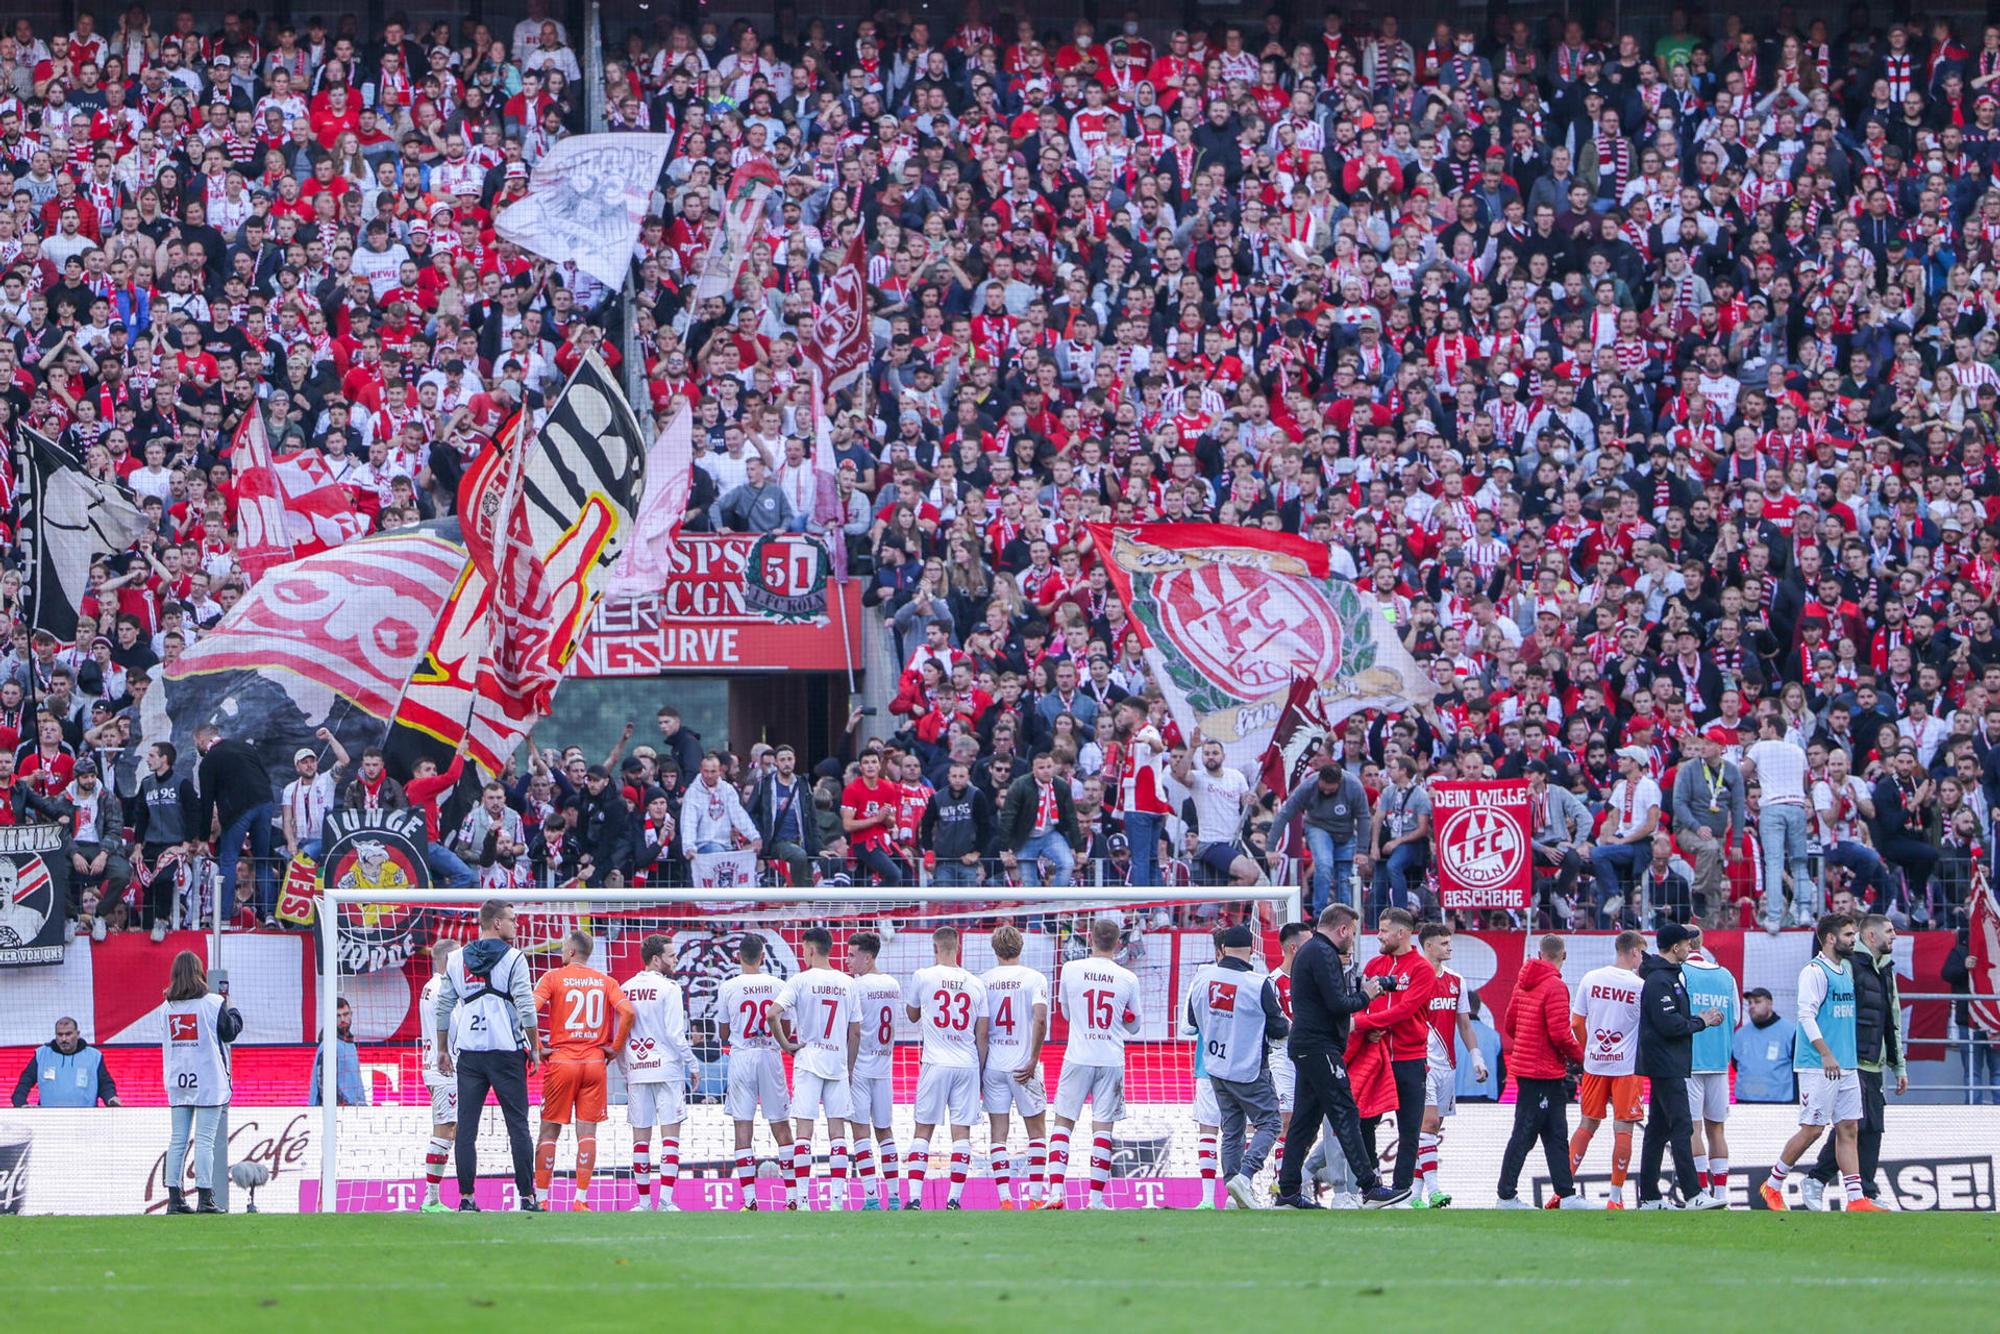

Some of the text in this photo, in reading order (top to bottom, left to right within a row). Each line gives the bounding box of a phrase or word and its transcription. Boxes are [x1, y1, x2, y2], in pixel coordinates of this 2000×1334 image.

[370, 270, 397, 280] REWE
[670, 540, 746, 575] SPS
[765, 557, 810, 589] 51
[666, 580, 746, 616] CGN
[661, 629, 740, 662] URVE
[160, 787, 176, 799] 96
[1435, 787, 1528, 808] DEIN WILLE
[327, 807, 424, 840] JUNGE
[1457, 830, 1503, 865] 1.FC
[1459, 863, 1505, 880] KÖLN
[281, 860, 318, 918] SEK
[1443, 889, 1524, 908] GESCHEHE
[19, 948, 41, 961] VON
[44, 946, 63, 960] UNS
[942, 979, 964, 991] DIETZ
[989, 980, 1022, 990] HÜBERS
[1084, 971, 1115, 984] KILIAN
[743, 985, 773, 996] SKHIRI
[1591, 985, 1636, 1004] REWE
[1692, 992, 1729, 1008] REWE
[564, 988, 605, 1030] 20
[821, 998, 839, 1039] 7
[933, 989, 972, 1032] 33
[995, 996, 1016, 1036] 4
[1083, 988, 1116, 1030] 15
[878, 1005, 893, 1045] 8
[1209, 1040, 1226, 1060] 01
[1590, 1051, 1624, 1062] hummel
[629, 1058, 661, 1070] hummel
[177, 1072, 198, 1089] 02
[1135, 1181, 1164, 1209] T
